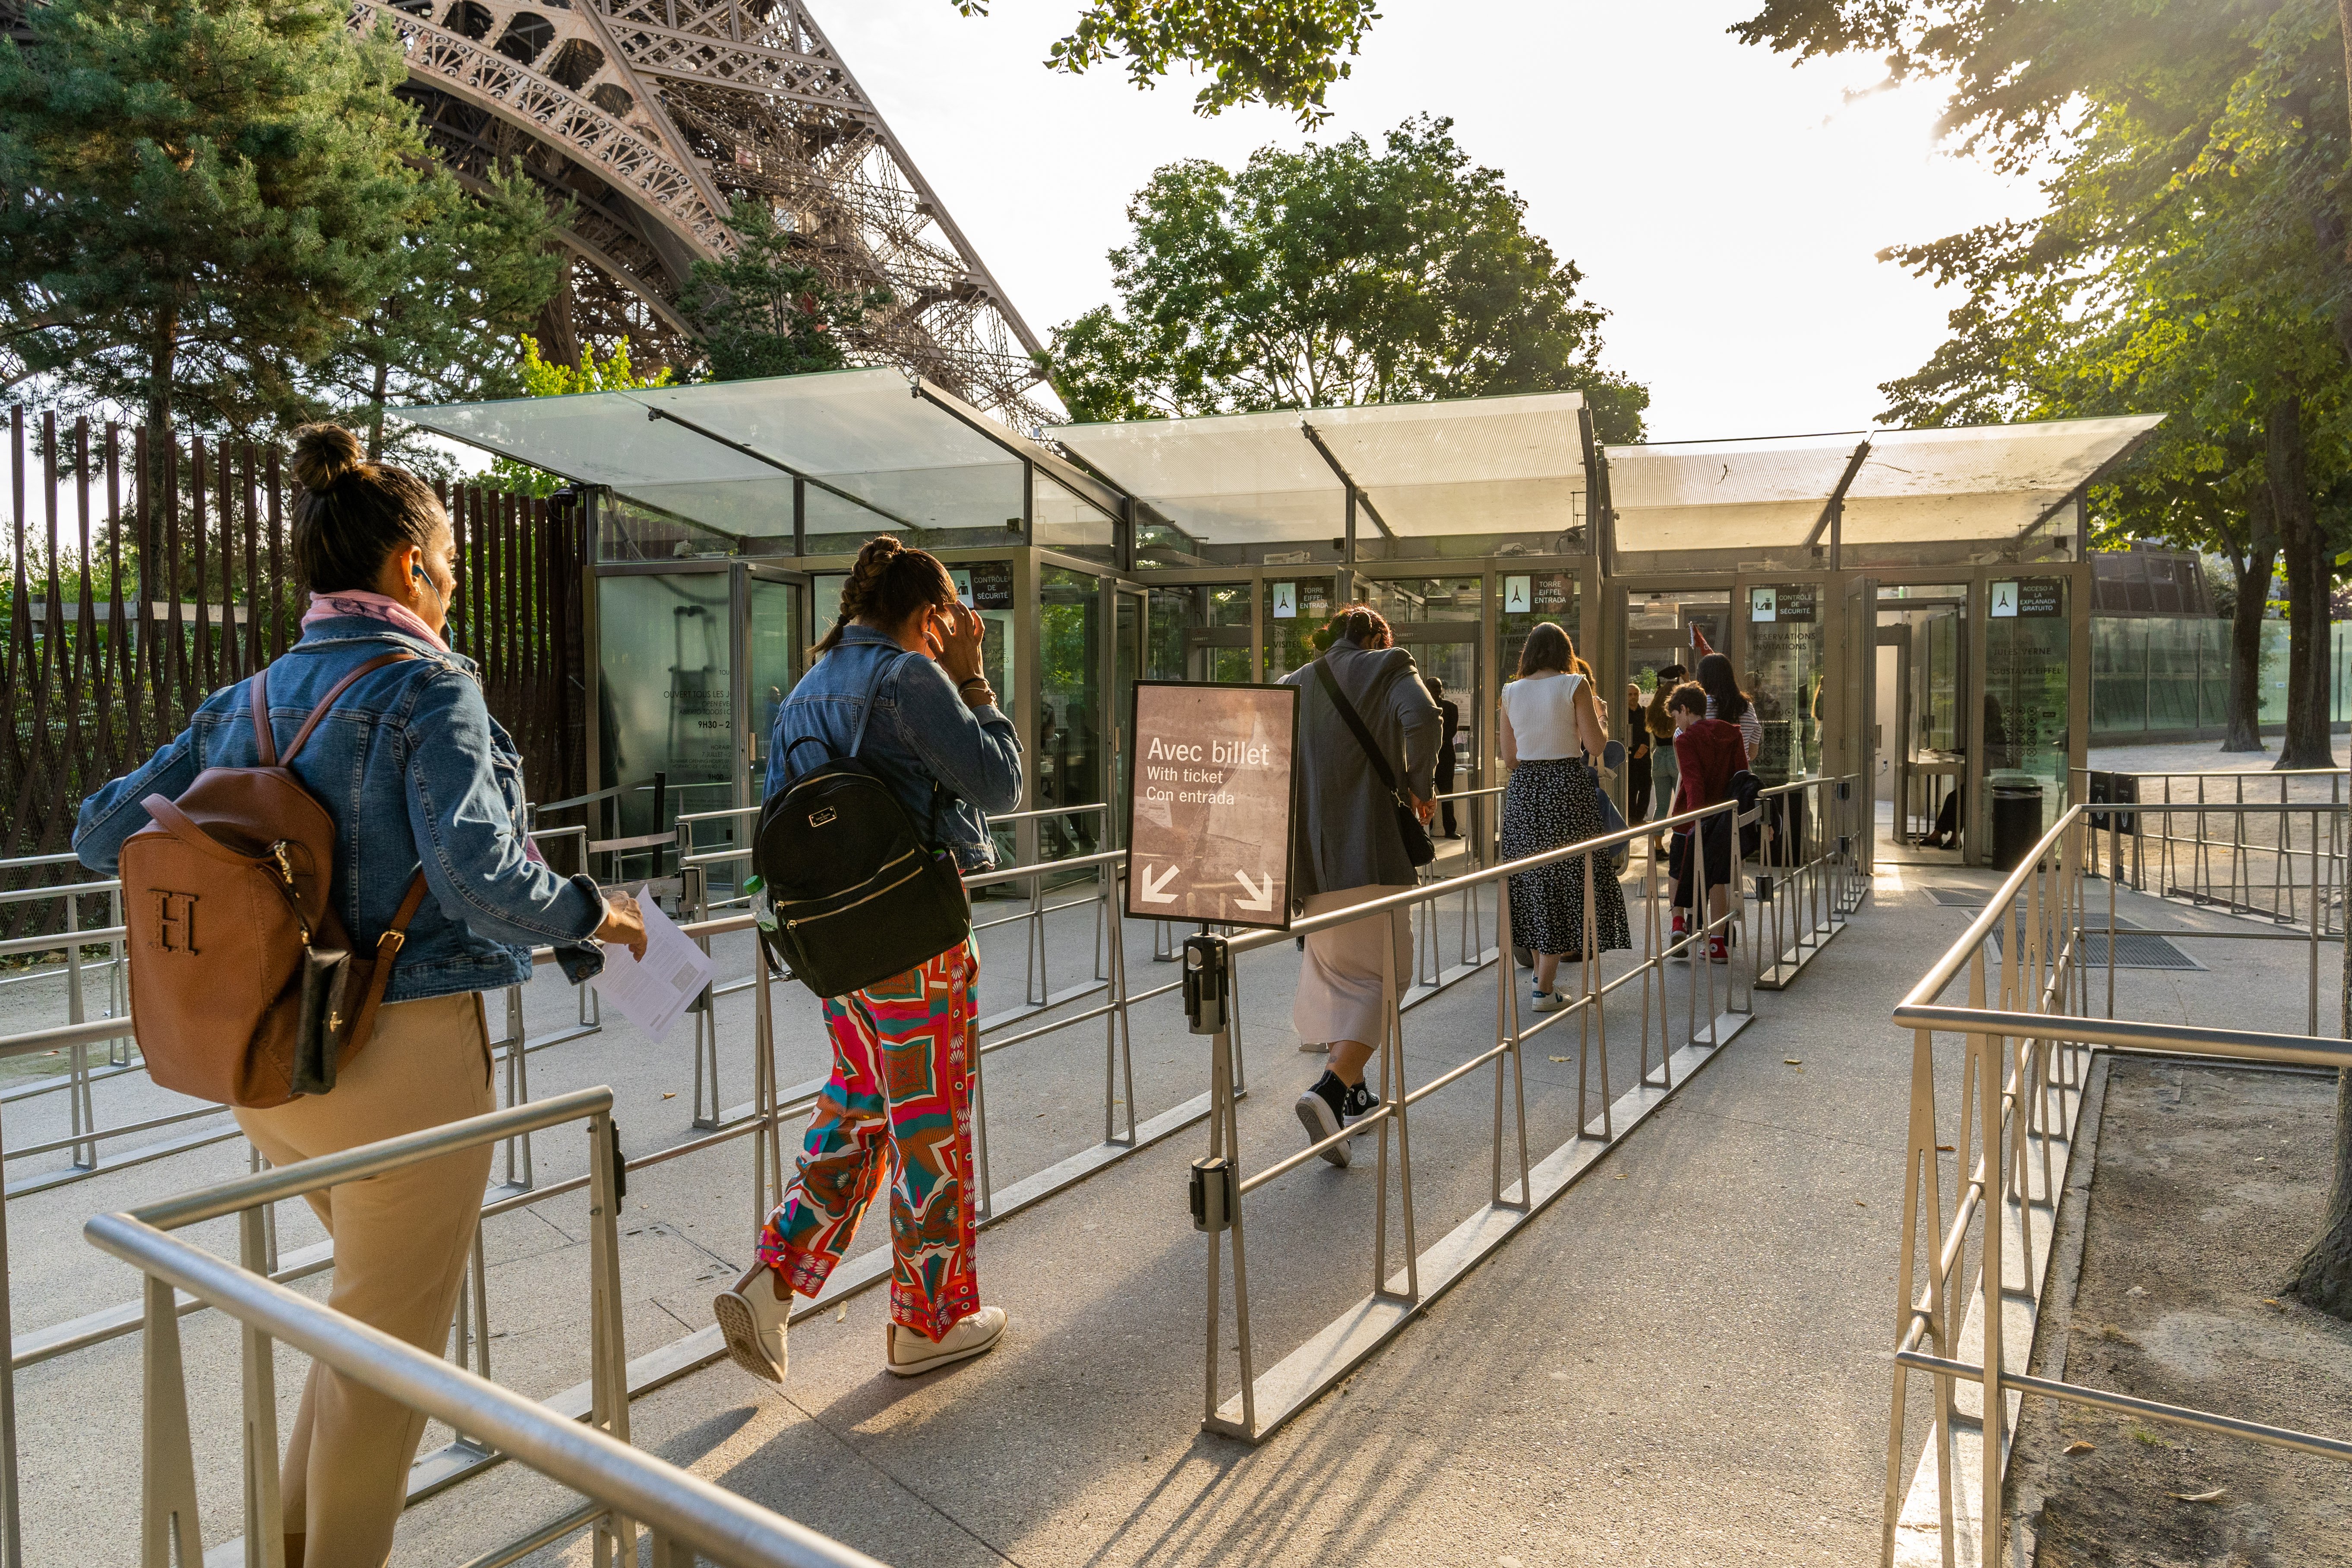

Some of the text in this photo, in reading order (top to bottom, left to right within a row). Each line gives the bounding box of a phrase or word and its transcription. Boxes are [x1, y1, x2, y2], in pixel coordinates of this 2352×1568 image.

[977, 591, 1008, 599] SÉCURITÉ
[1147, 738, 1269, 765] Avec billet
[1147, 766, 1223, 784] With ticket
[1146, 787, 1234, 805] Con entrada
[147, 888, 199, 957] H
